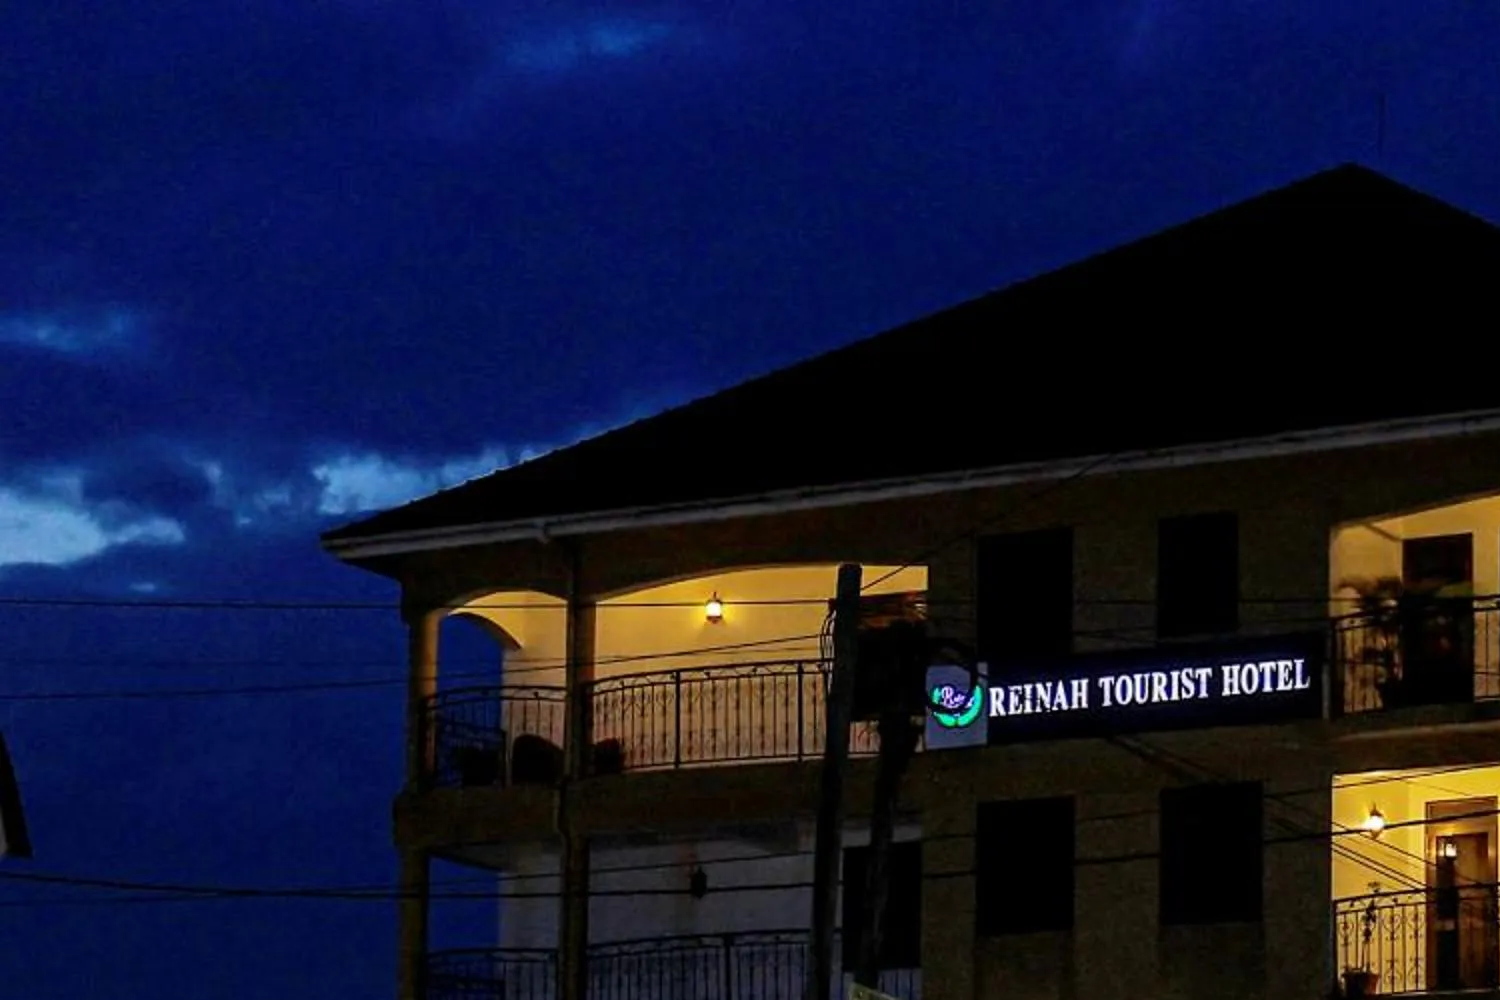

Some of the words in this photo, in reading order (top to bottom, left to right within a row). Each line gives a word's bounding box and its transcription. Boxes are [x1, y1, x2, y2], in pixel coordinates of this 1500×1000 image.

[989, 679, 1089, 717] REINAH
[1099, 667, 1212, 708] TOURIST
[1220, 658, 1311, 697] HOTEL
